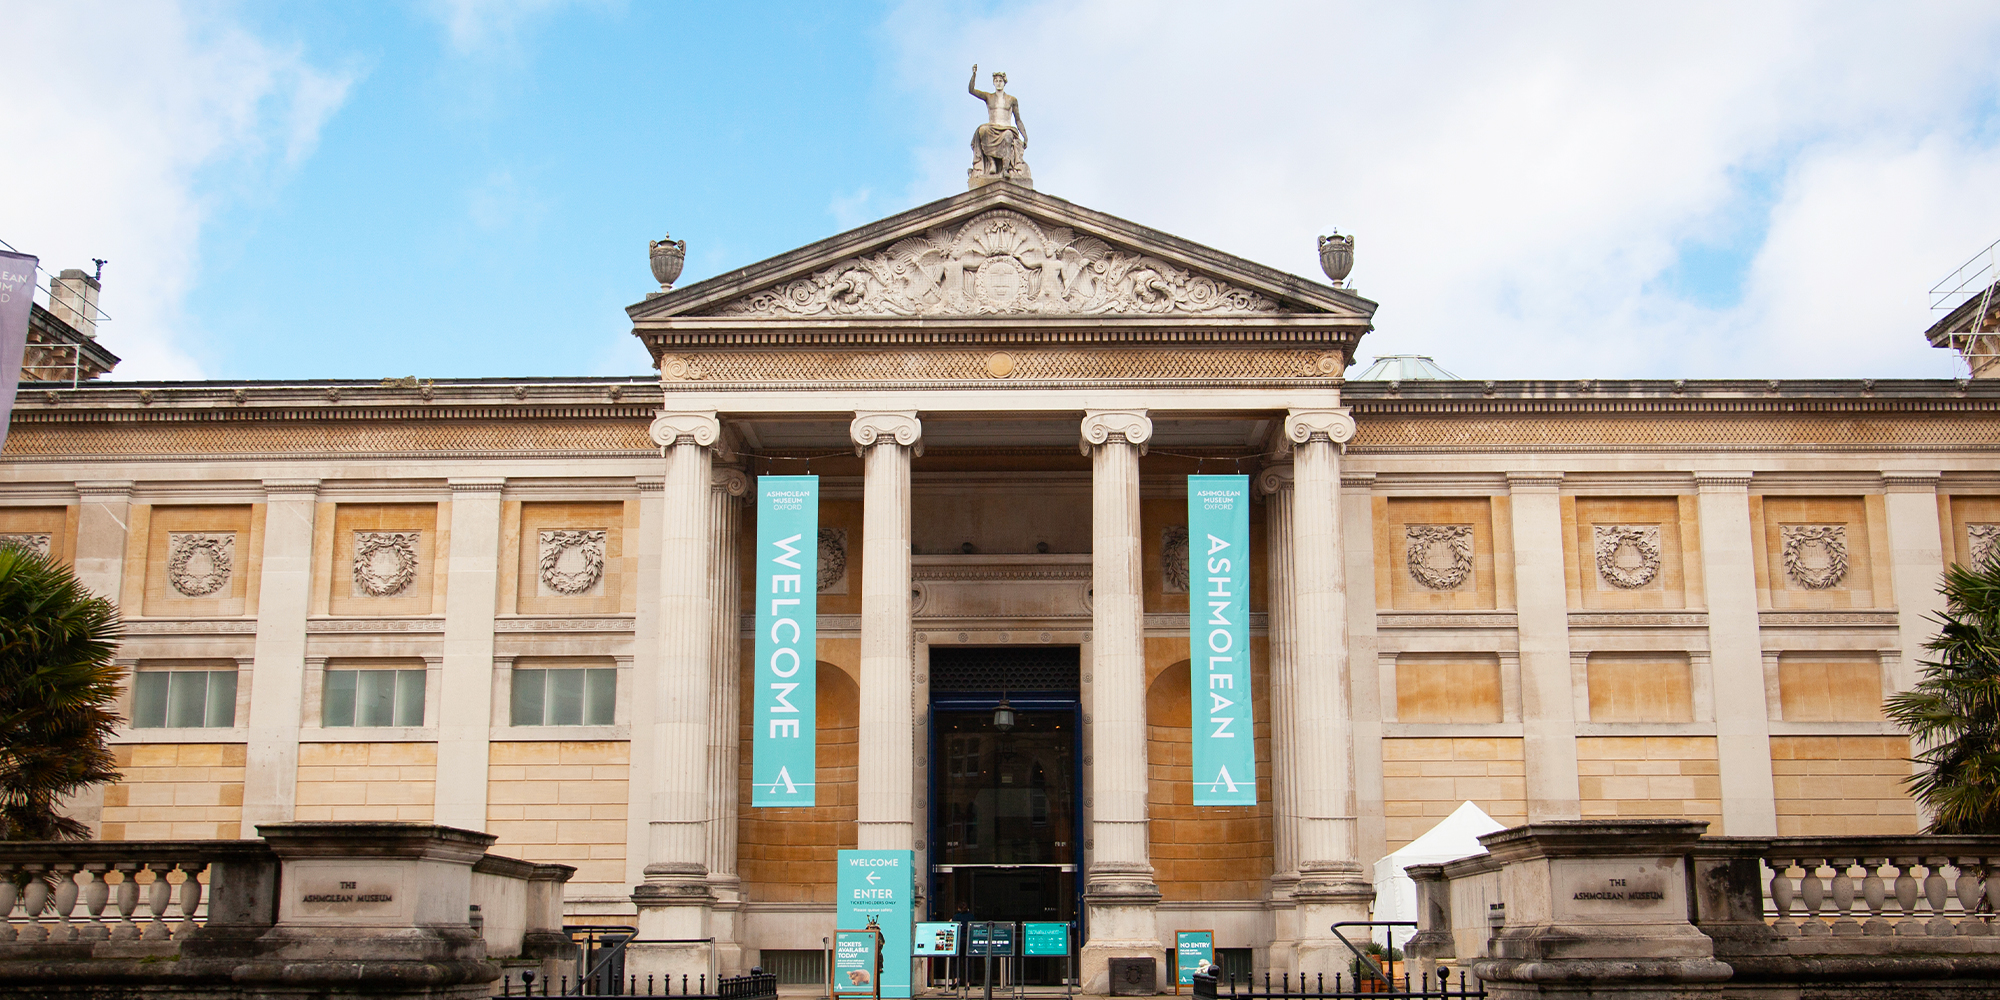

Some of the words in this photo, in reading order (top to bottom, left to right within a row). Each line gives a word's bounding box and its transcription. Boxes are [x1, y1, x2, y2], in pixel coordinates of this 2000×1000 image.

[0, 271, 27, 283] EAN
[770, 533, 801, 738] WELCOME
[1207, 533, 1235, 738] ASHMOLEAN
[769, 765, 798, 794] A
[1210, 764, 1239, 792] A
[849, 858, 899, 867] WELCOME
[853, 888, 893, 899] ENTER
[1573, 892, 1624, 900] ASHMOLEAN
[1628, 892, 1664, 900] MUSEUM
